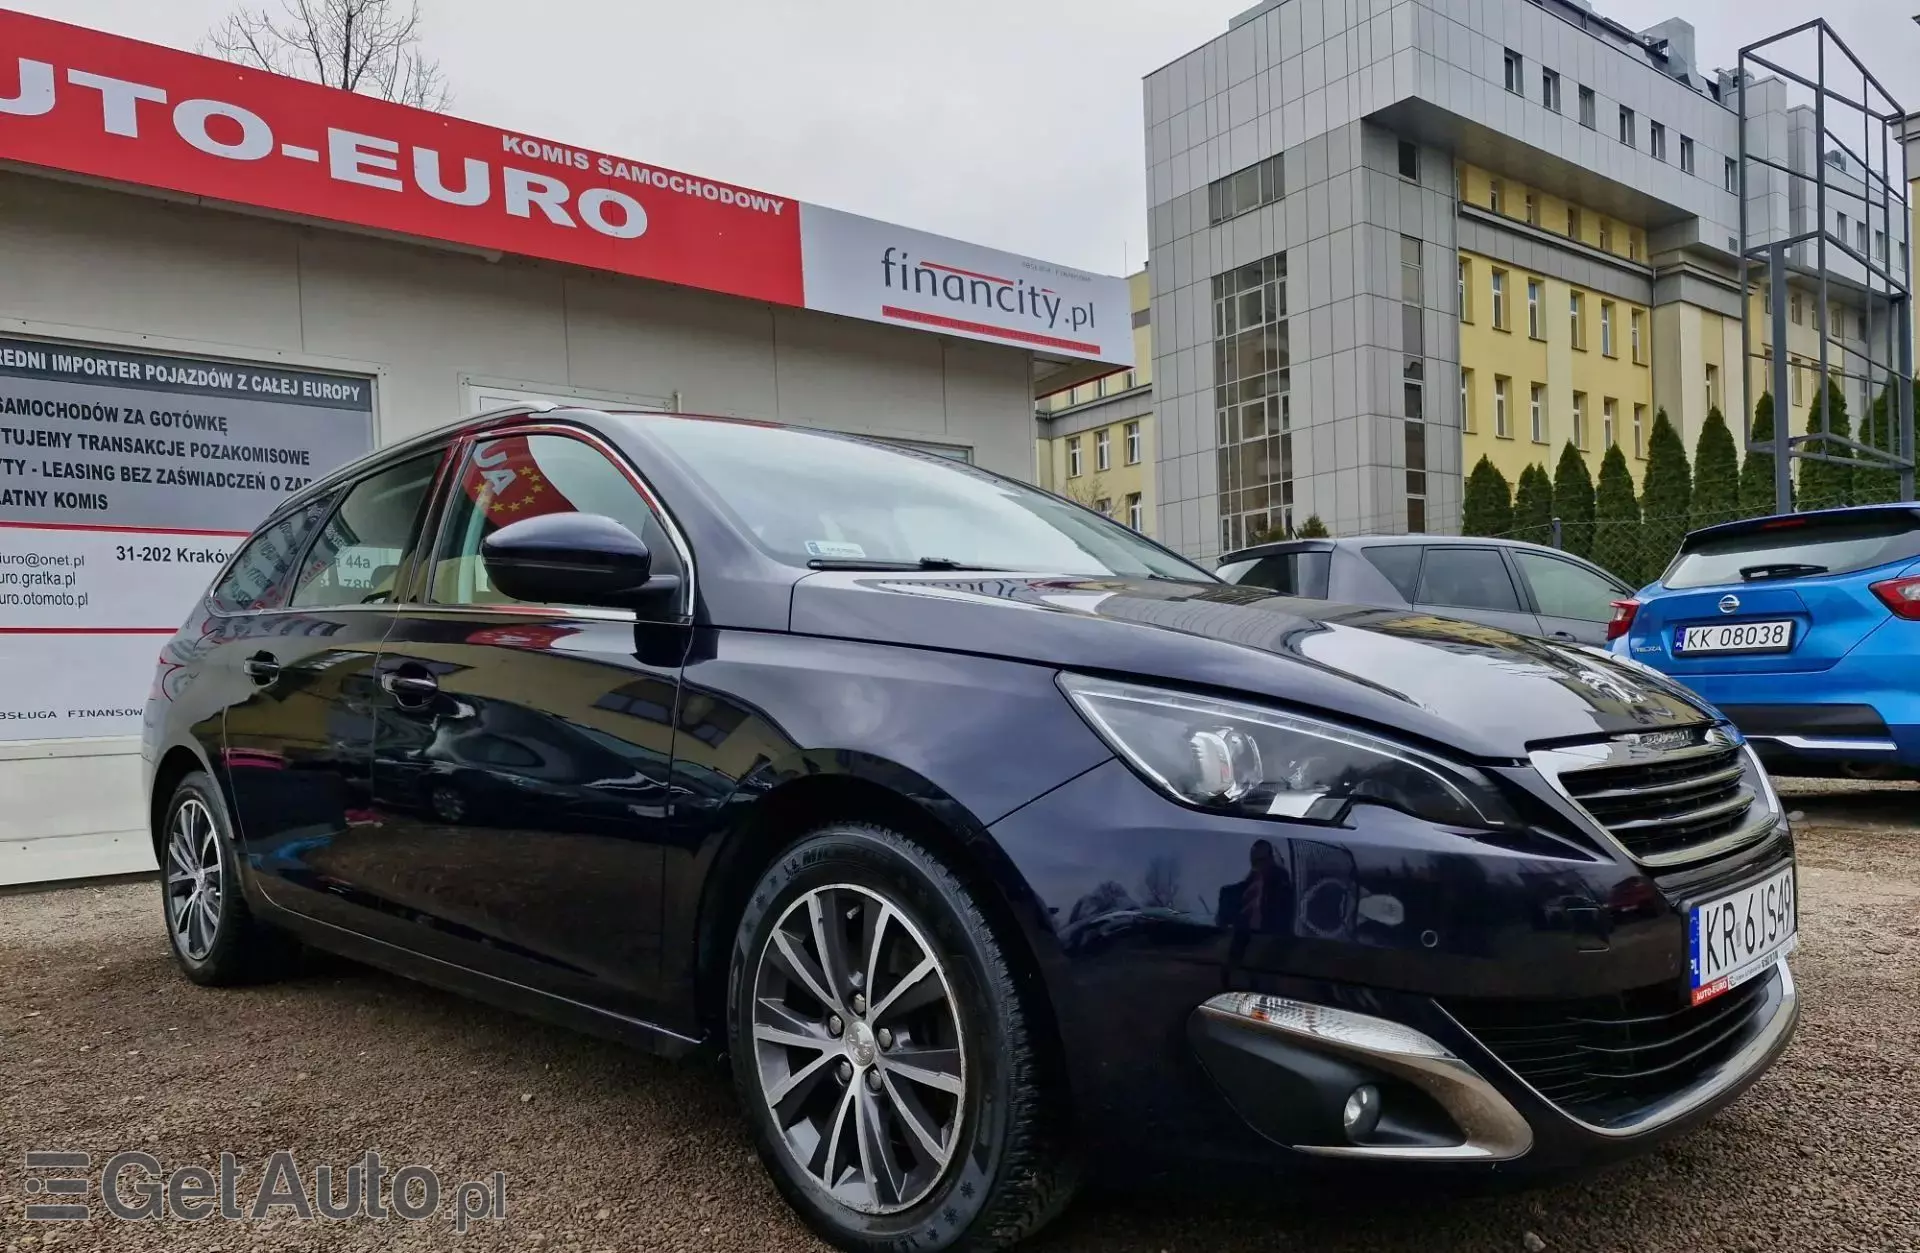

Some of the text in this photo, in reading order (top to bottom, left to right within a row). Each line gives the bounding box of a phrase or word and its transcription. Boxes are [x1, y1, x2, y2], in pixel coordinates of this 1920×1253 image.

[502, 134, 784, 216] KOMIS SAMOCHODOWY
[881, 247, 1095, 332] financity.pl
[52, 354, 141, 380] IMPORTER
[145, 364, 233, 389] POJAZDÓW
[237, 374, 248, 391] Z
[251, 375, 299, 396] CAŁEJ
[302, 381, 360, 402] EUROPY
[123, 408, 146, 425] ZA
[149, 410, 228, 436] GOTÓWKĘ
[0, 427, 310, 466] TUJEMY TRANSAKCJE POZAKOMISOWE
[0, 458, 26, 476] TY
[42, 461, 115, 482] LEASING
[120, 465, 151, 484] BEZ
[156, 466, 266, 491] ZAŚWIADCZEŃ
[270, 475, 281, 492] O
[0, 489, 109, 510] ATNY KOMIS
[116, 545, 172, 562] 31-202
[1687, 625, 1784, 648] KK 08038
[1706, 875, 1791, 975] KR 6JS49
[1696, 980, 1728, 1002] AUTO-EURO
